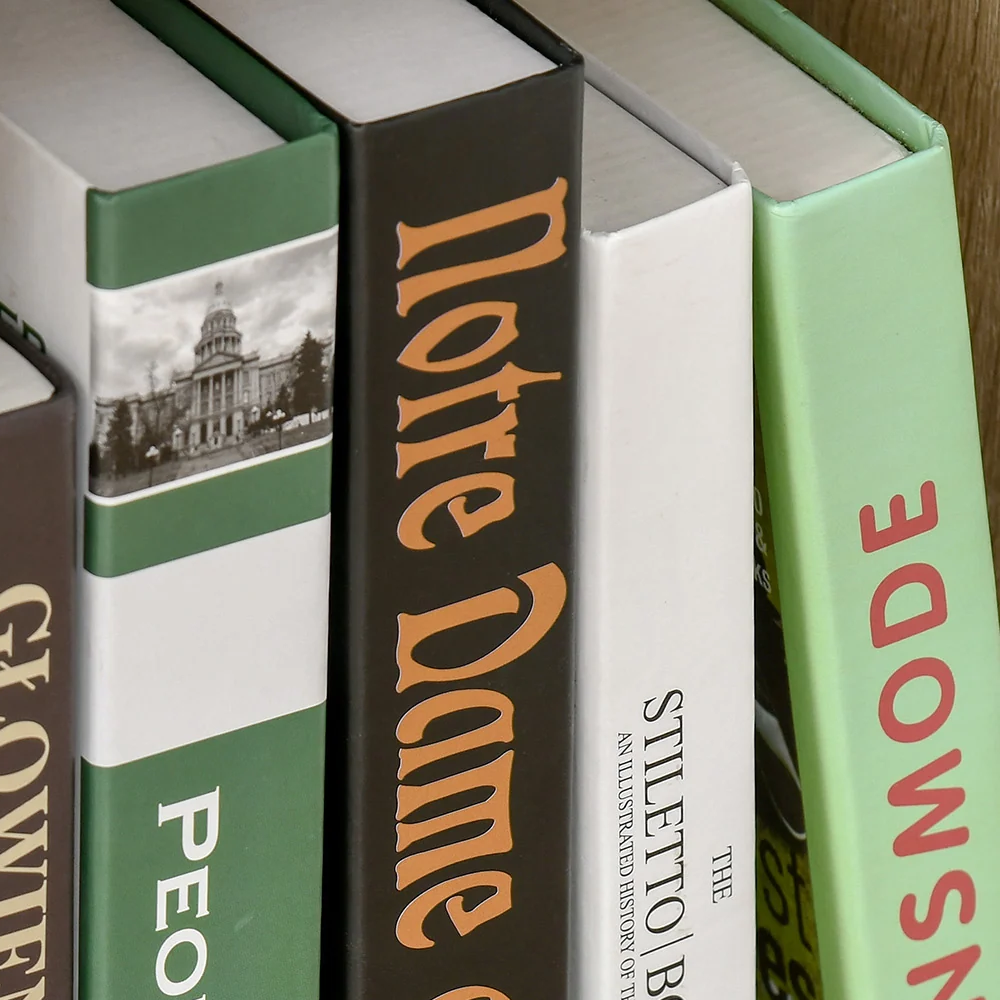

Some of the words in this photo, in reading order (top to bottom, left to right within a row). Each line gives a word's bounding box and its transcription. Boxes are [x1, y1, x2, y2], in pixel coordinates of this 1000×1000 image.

[396, 563, 568, 950] Dame
[617, 732, 633, 757] AN
[617, 758, 634, 878] ILLUSTRATED
[711, 845, 733, 904] THE
[619, 879, 635, 954] HISTORY
[620, 957, 635, 980] OF
